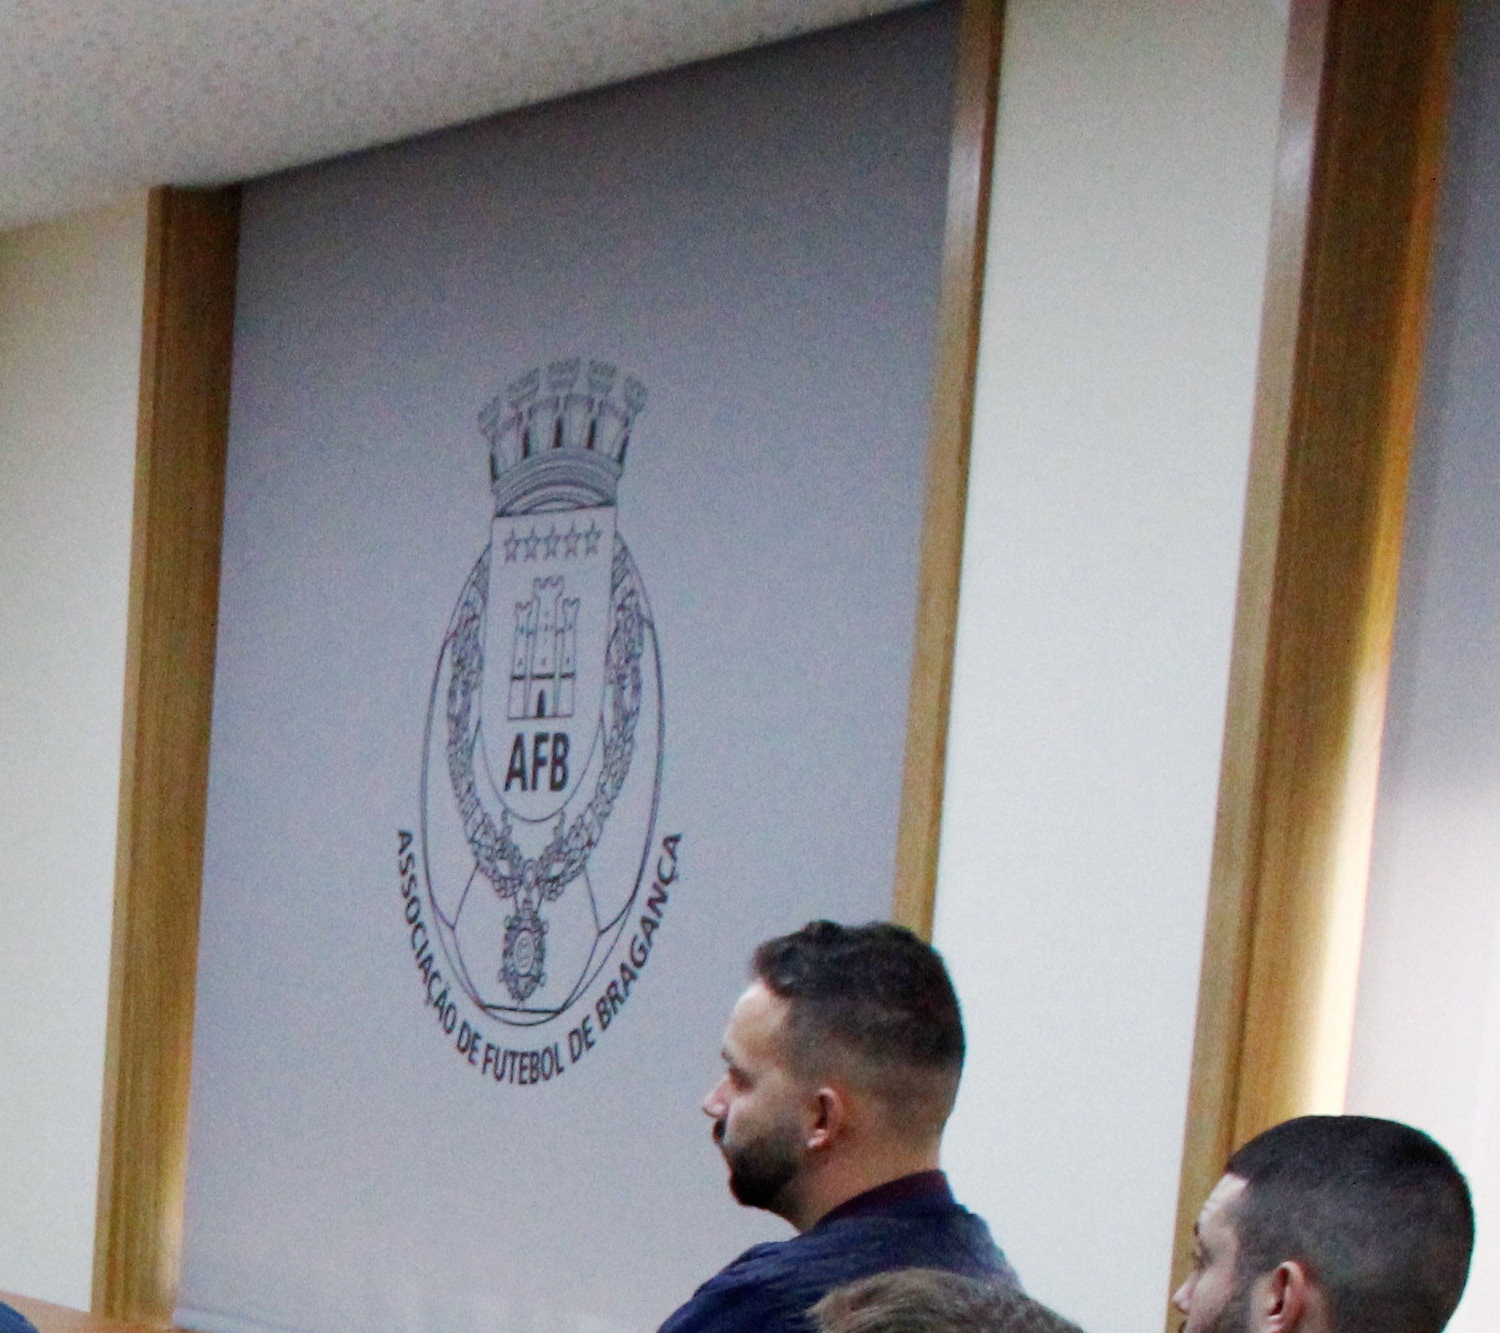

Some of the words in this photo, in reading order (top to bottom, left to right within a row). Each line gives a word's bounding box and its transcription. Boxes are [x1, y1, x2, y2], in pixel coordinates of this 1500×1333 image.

[503, 730, 572, 793] AFB
[397, 829, 459, 1036] ASSOCIAÇÃO
[456, 1020, 484, 1067] DE
[481, 1042, 566, 1087] FUTEBOL
[567, 1014, 597, 1065] DE
[595, 832, 684, 1033] BRAGANÇA
